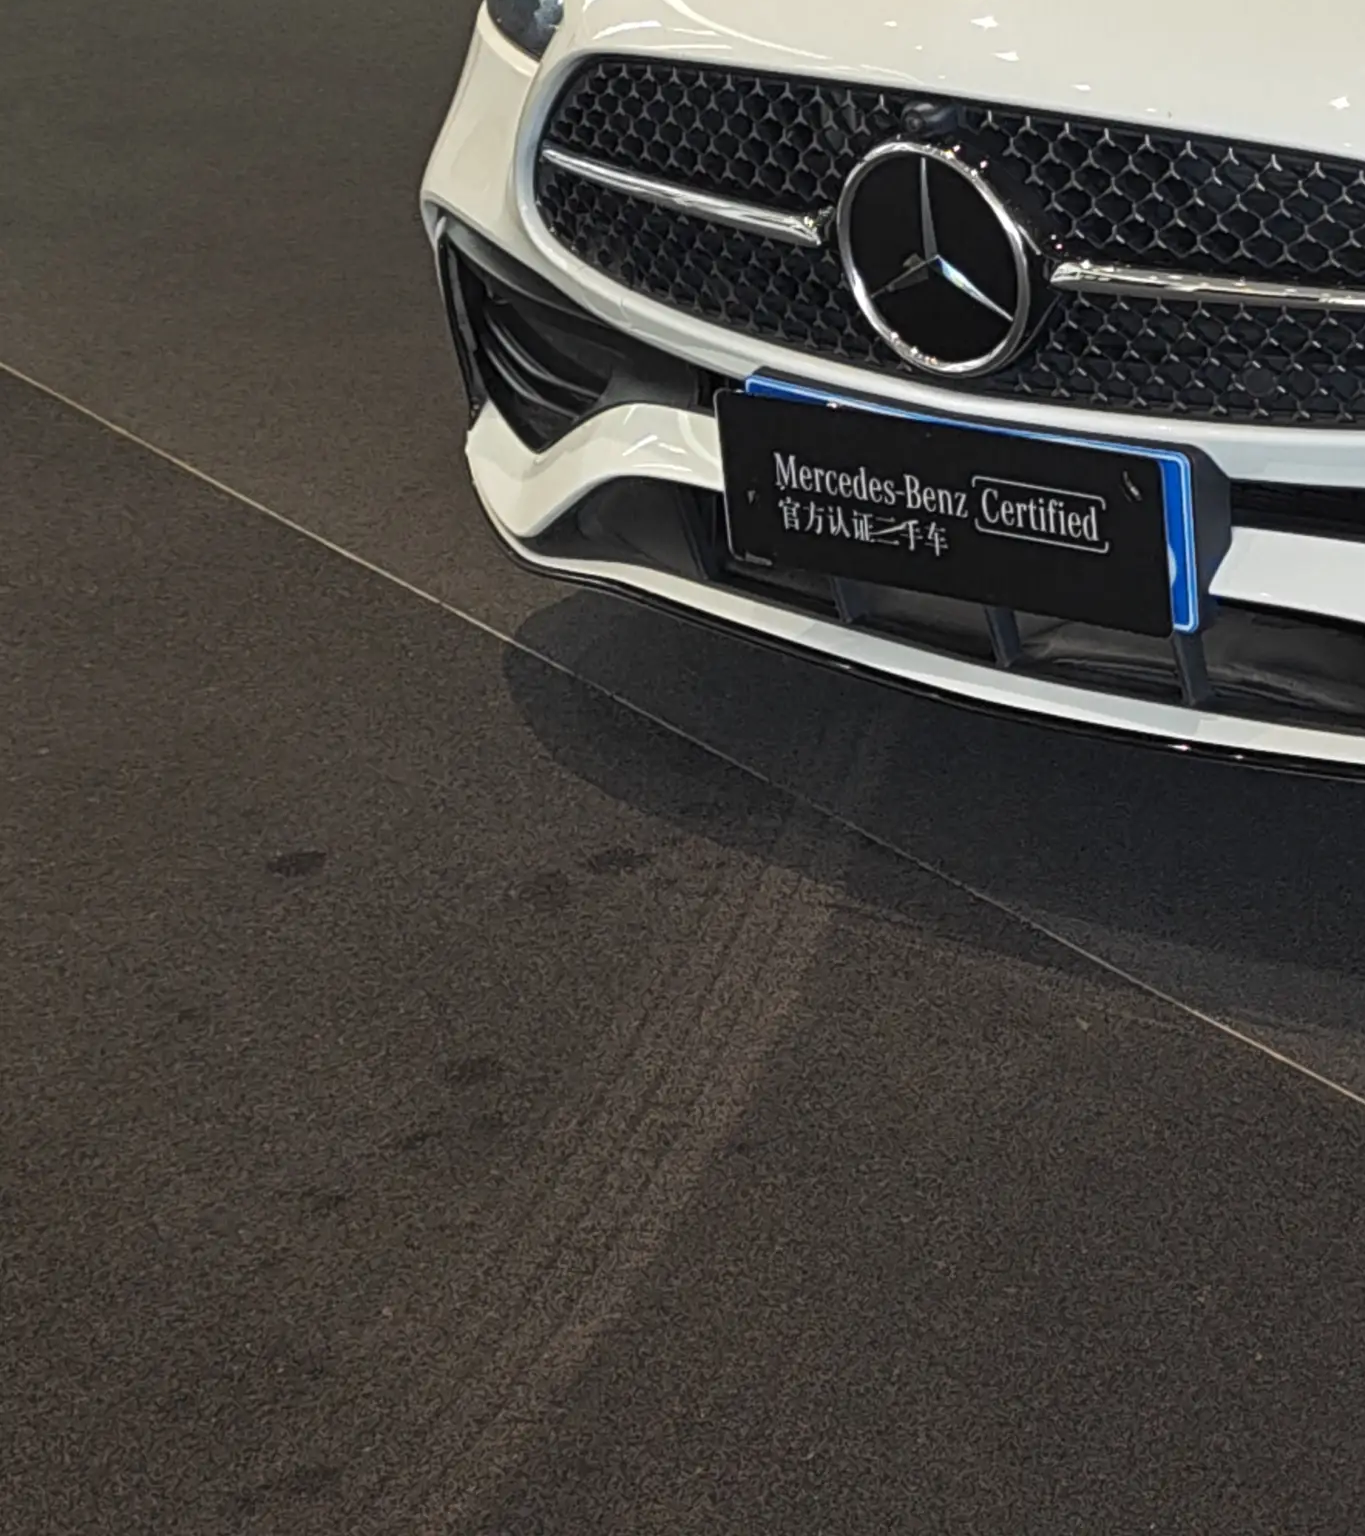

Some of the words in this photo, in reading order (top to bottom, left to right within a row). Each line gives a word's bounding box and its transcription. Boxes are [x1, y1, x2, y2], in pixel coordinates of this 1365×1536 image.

[773, 452, 969, 518] Mercedes-Benz
[980, 487, 1101, 542] Certified
[777, 497, 949, 557] 官方认证二手车
